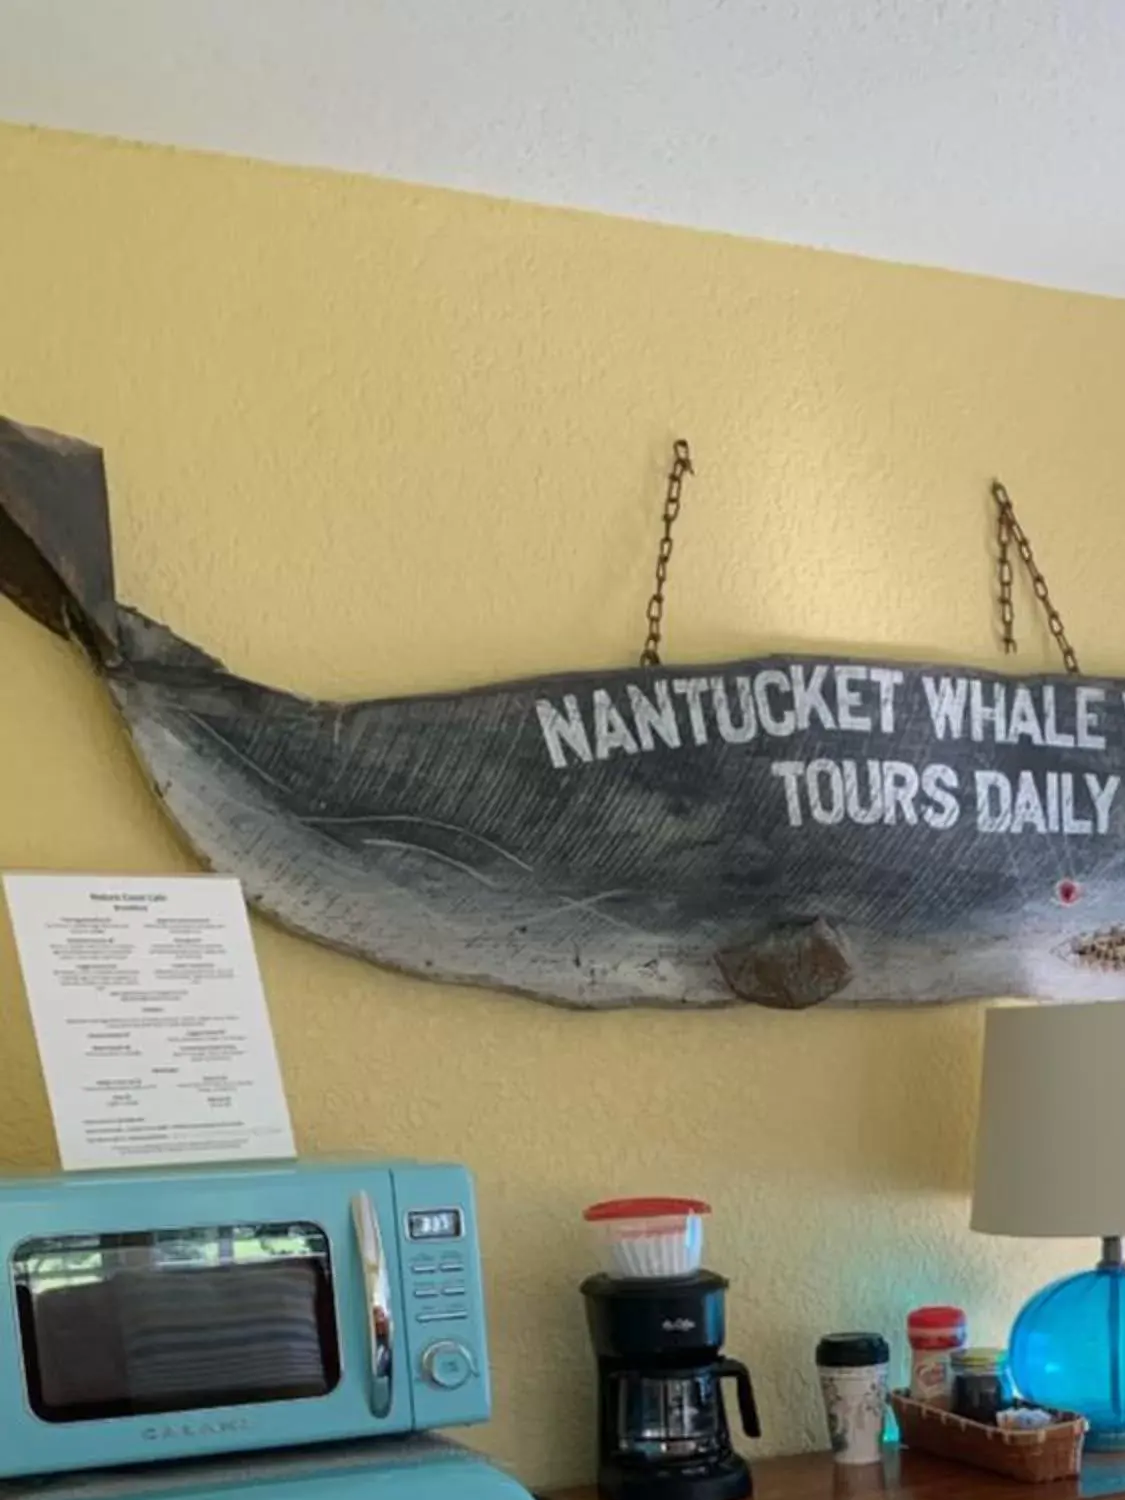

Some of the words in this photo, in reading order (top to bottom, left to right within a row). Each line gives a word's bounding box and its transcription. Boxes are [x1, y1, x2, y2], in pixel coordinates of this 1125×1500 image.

[536, 664, 904, 769] NANTUCKET
[922, 676, 1107, 750] WHALE
[771, 759, 960, 829] TOURS
[974, 770, 1121, 835] DAILY
